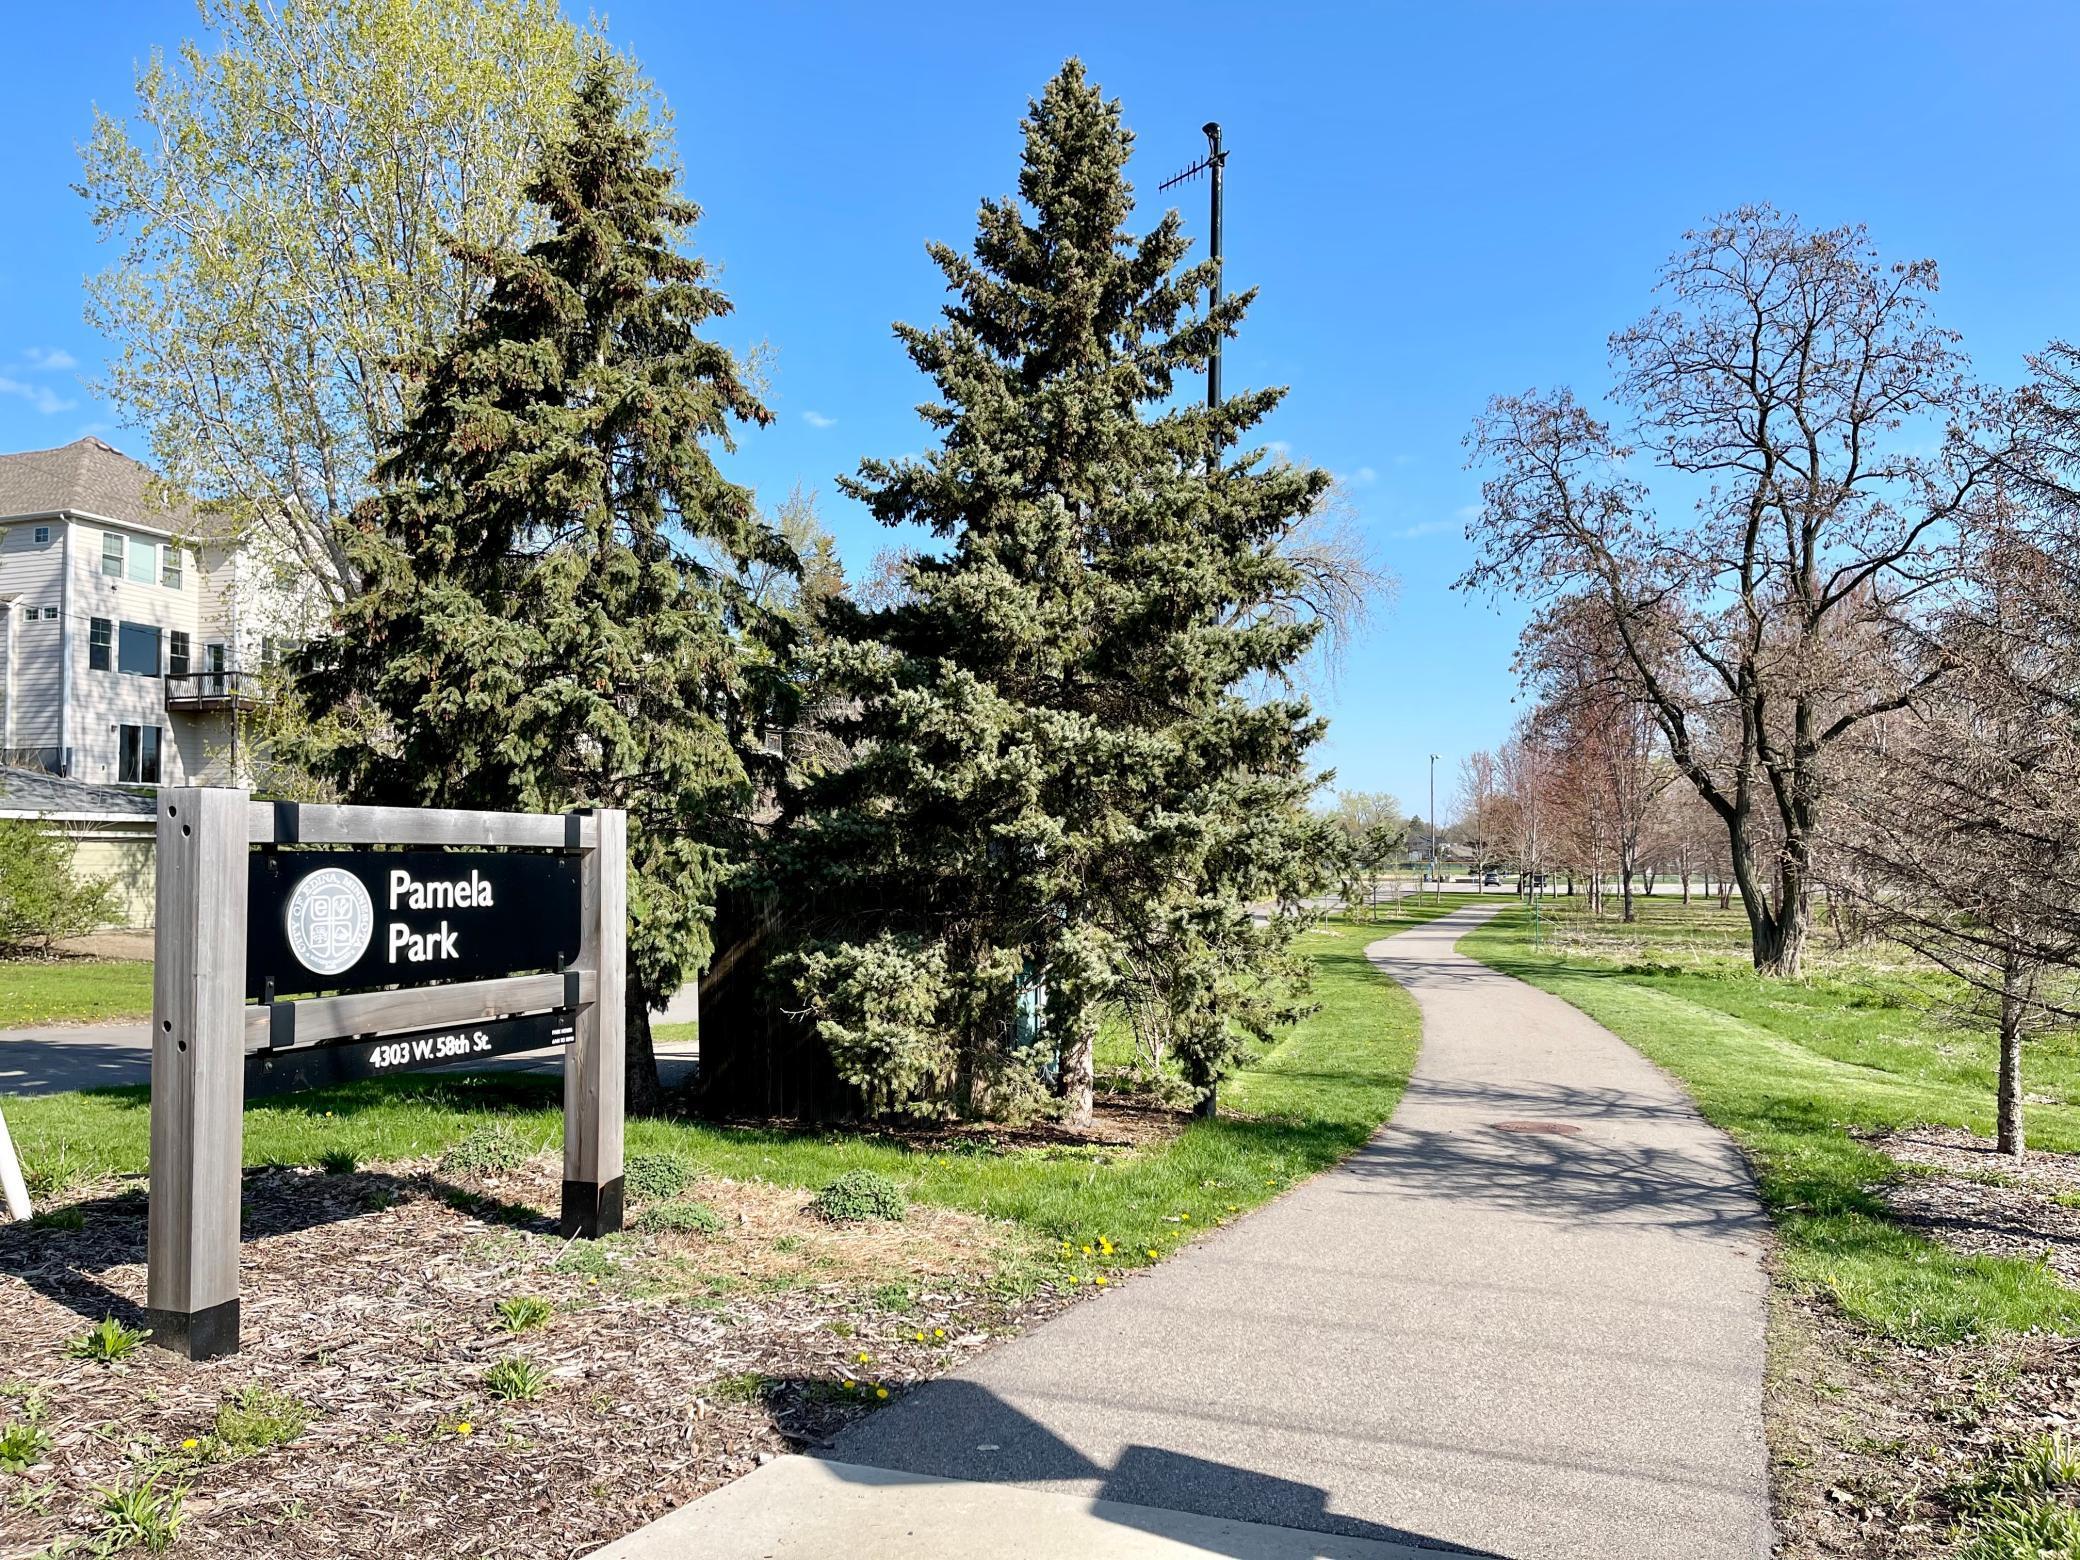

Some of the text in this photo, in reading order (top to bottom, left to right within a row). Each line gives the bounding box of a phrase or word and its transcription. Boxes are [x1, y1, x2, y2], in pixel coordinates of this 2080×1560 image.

[293, 897, 304, 917] OF
[389, 869, 494, 911] Pamela
[389, 920, 460, 964] Park
[369, 1031, 492, 1068] 4303 W. 58th St.
